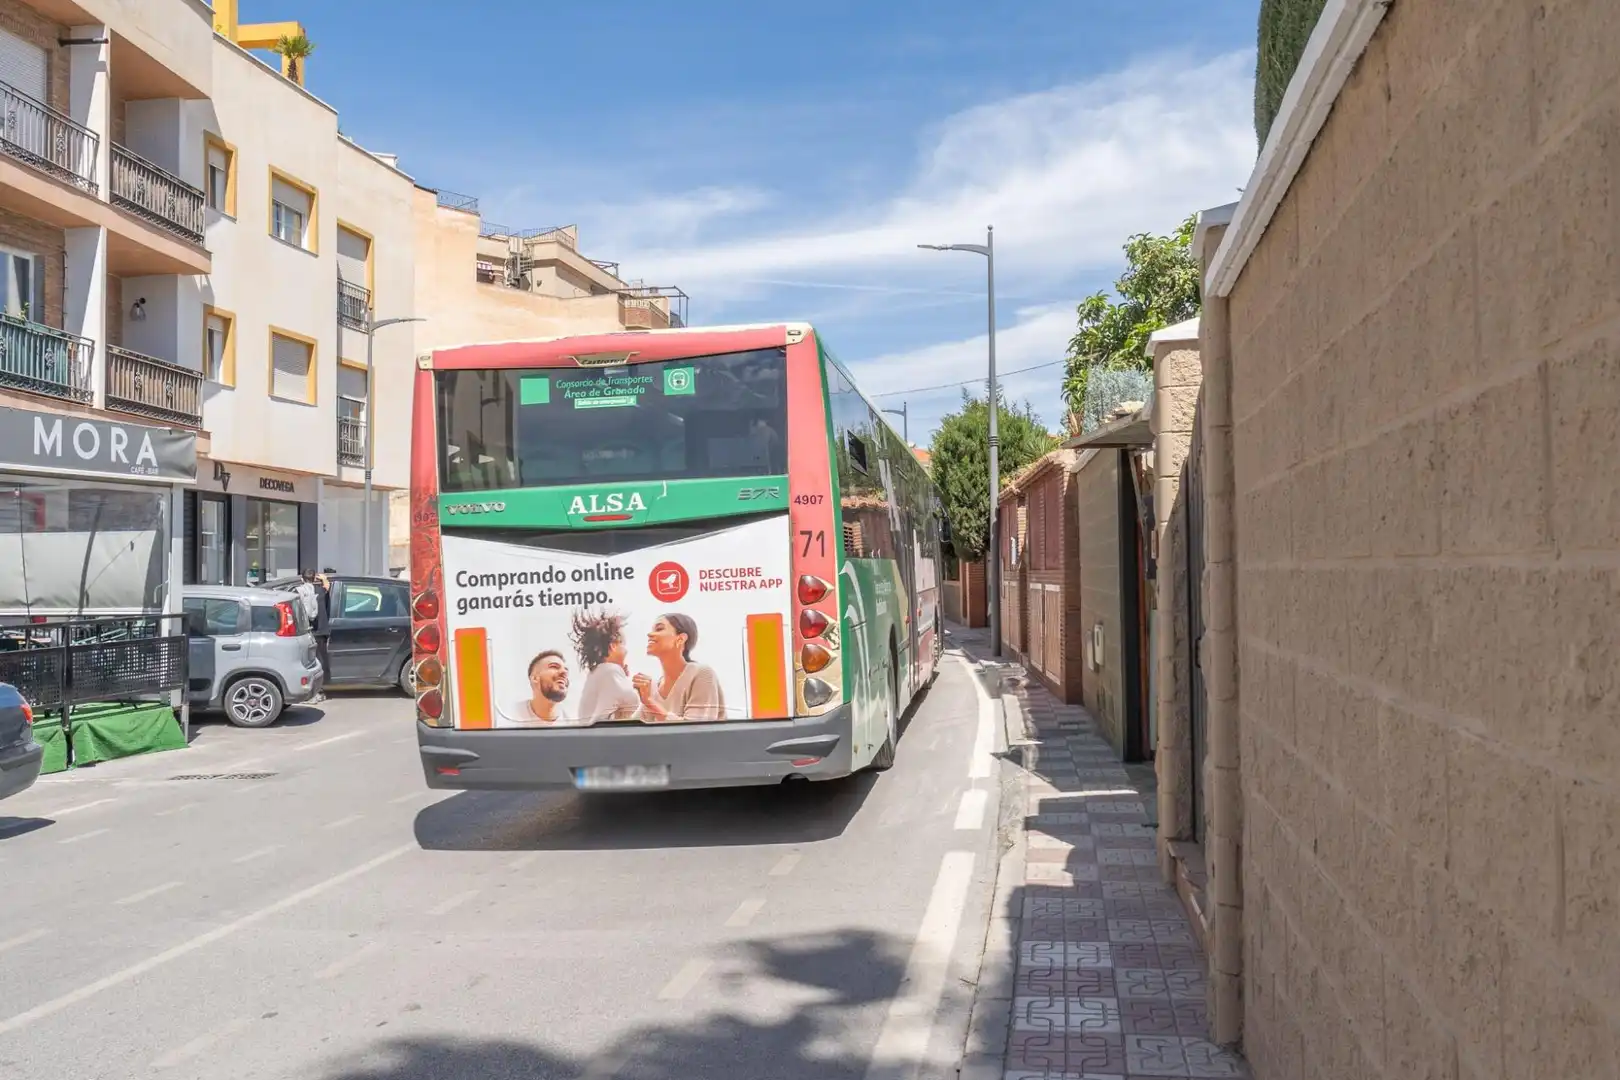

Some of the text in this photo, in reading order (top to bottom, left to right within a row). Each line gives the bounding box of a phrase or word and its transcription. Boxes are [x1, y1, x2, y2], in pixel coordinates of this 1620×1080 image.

[556, 379, 595, 388] Consorcio
[608, 375, 653, 387] Transportes
[589, 388, 601, 396] de
[603, 386, 645, 395] Granada
[33, 416, 158, 468] MORA
[567, 492, 648, 515] ALSA
[794, 494, 824, 505] 4907
[445, 502, 507, 515] VOLVO
[800, 530, 826, 558] 71
[455, 562, 635, 591] Comprando online
[699, 567, 762, 580] DESCUBRE
[699, 578, 783, 592] NUESTRA APP
[456, 588, 614, 616] ganarás tiempo.
